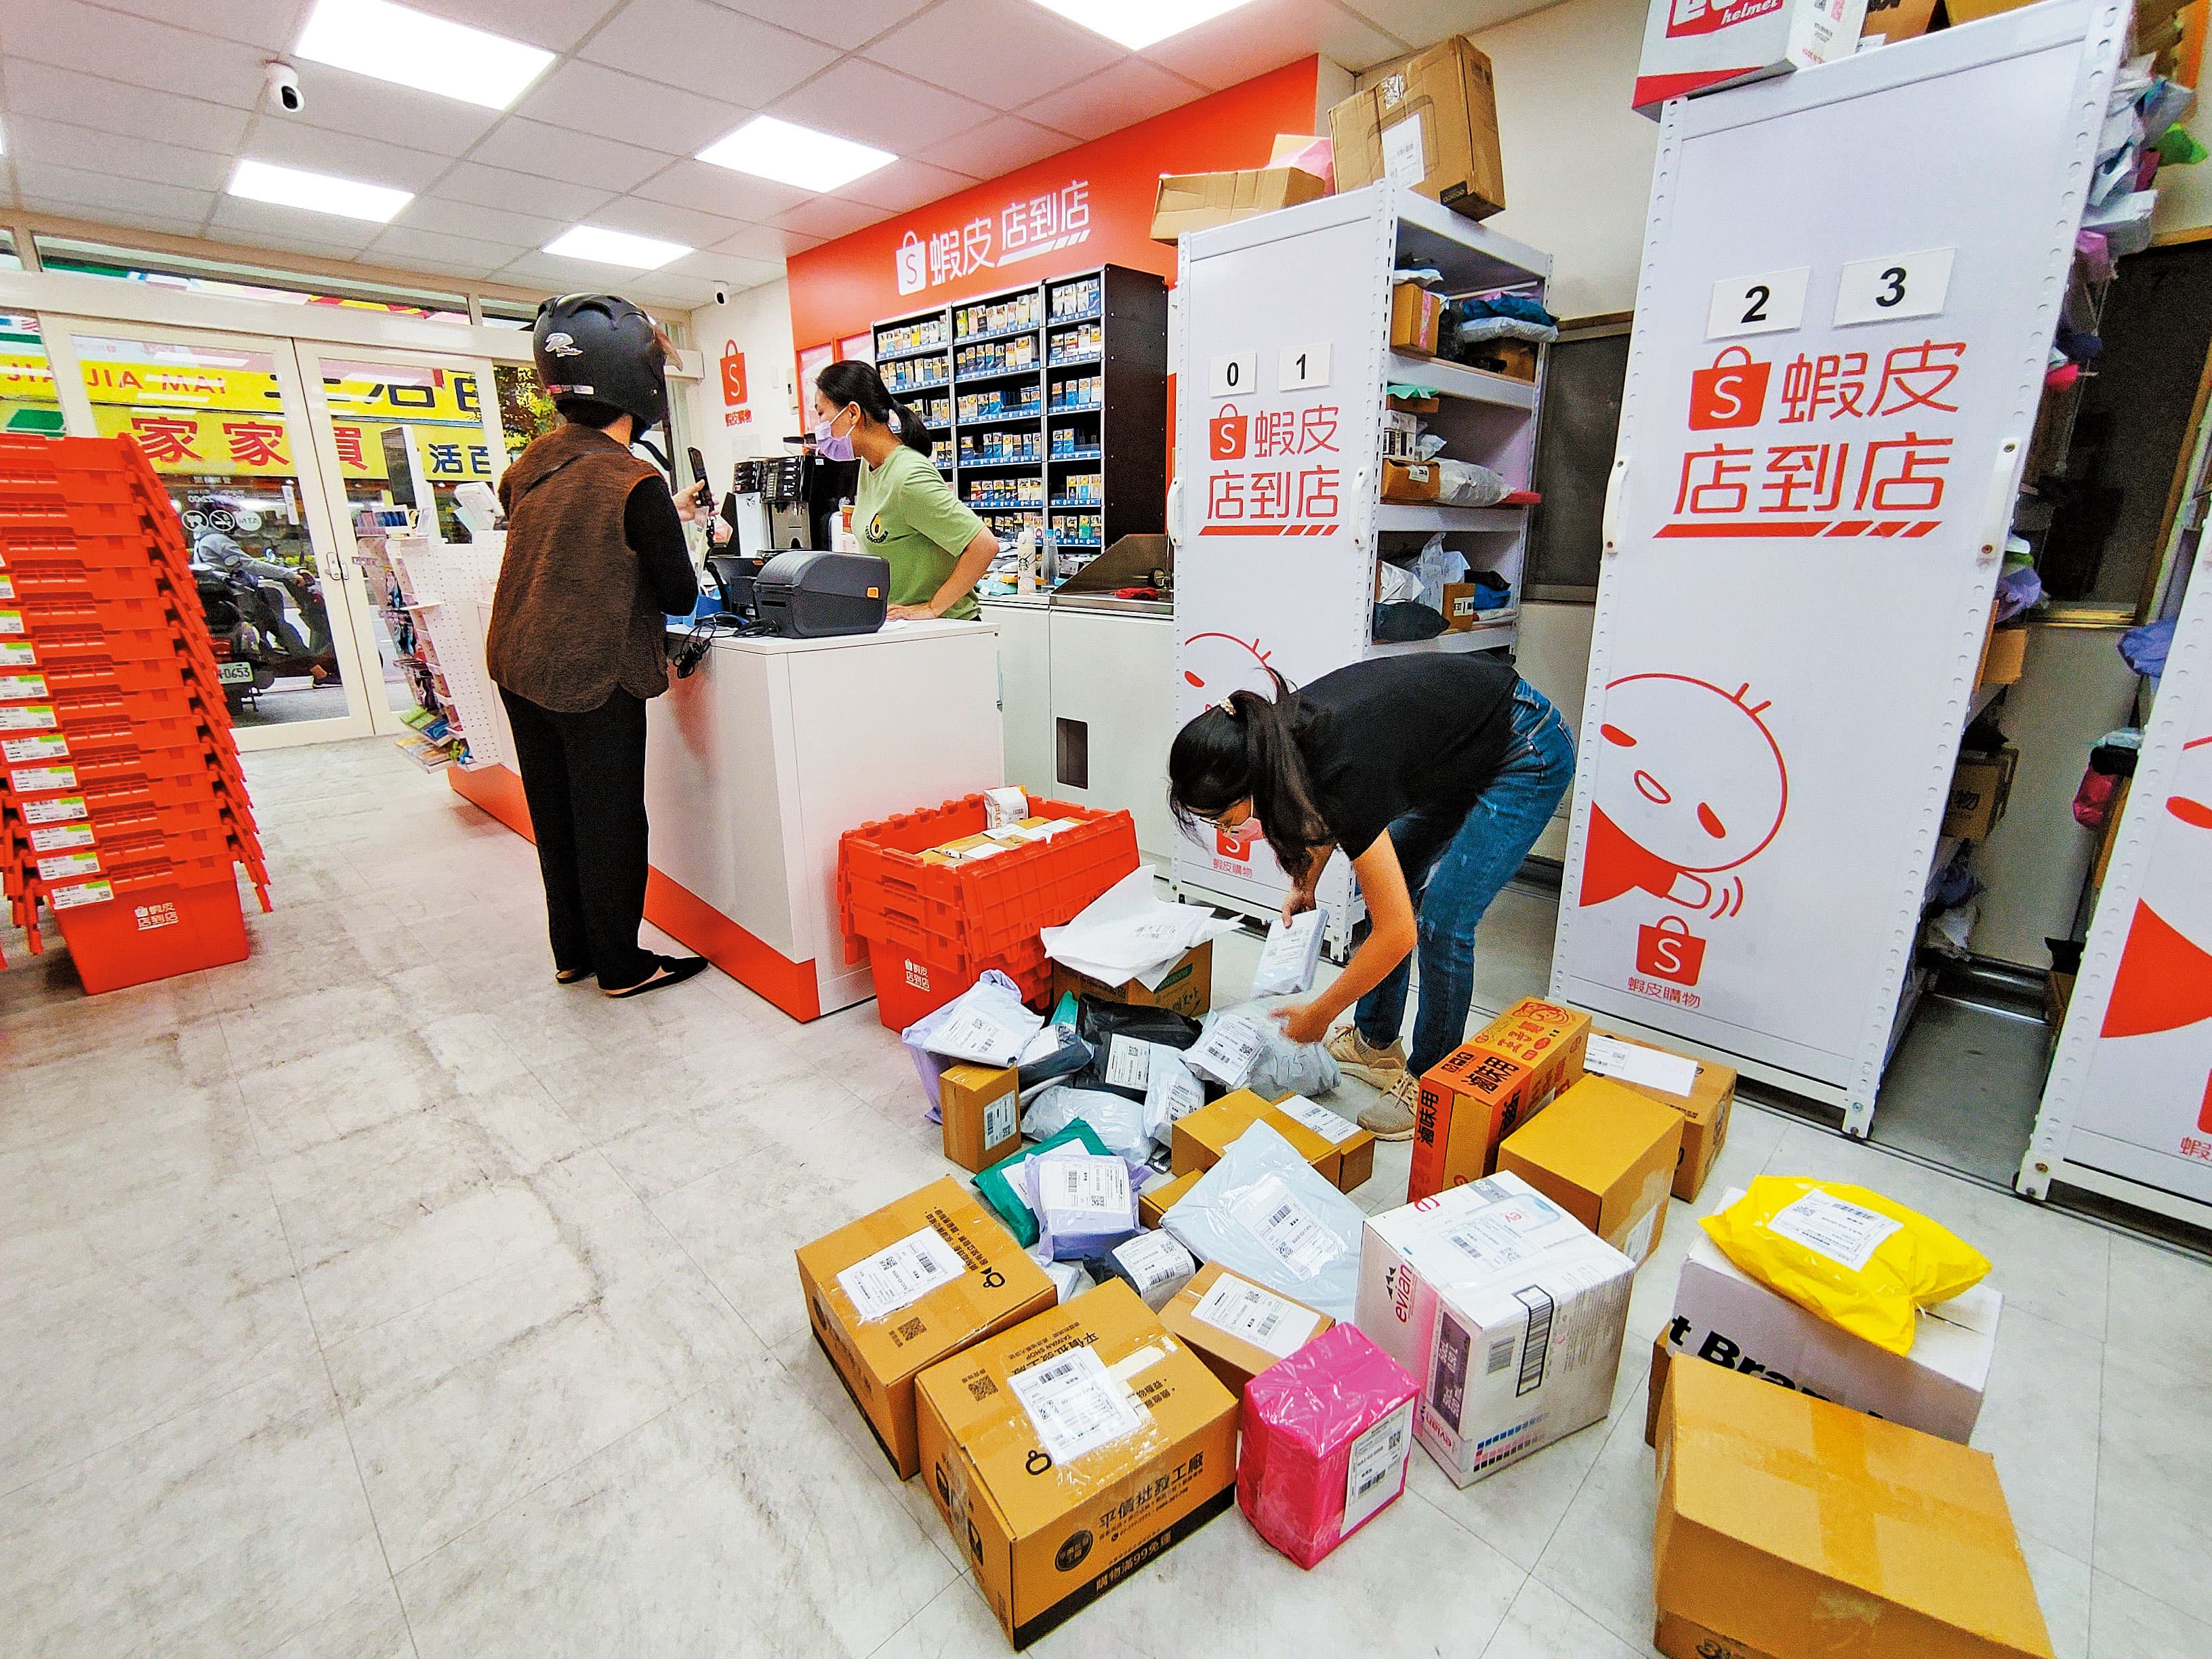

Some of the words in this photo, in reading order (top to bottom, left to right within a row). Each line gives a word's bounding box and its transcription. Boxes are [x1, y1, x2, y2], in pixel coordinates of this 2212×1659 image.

[930, 218, 994, 286] 蝦皮
[1001, 180, 1089, 250] 店到店
[1741, 285, 1771, 323] 2
[1876, 267, 1907, 307] 3
[87, 368, 144, 390] JIA
[1227, 362, 1239, 386] 0
[1296, 353, 1307, 380] 1
[1779, 340, 1967, 424] 蝦皮
[1254, 404, 1340, 458] 蝦皮
[1674, 432, 1954, 515] 店到店
[1208, 464, 1340, 519] 店到店
[1213, 858, 1252, 878] 蝦皮購物
[138, 912, 178, 928] 店到店
[906, 971, 929, 989] 店到店
[1628, 977, 1700, 1008] 蝦皮購物
[1461, 1057, 1519, 1094] 滷味用
[1417, 1089, 1439, 1148] 滷味用
[1395, 1263, 1412, 1323] evian
[1025, 1347, 1045, 1359] SHOP
[1046, 1334, 1071, 1350] TAIWAN
[1426, 1414, 1452, 1448] evian
